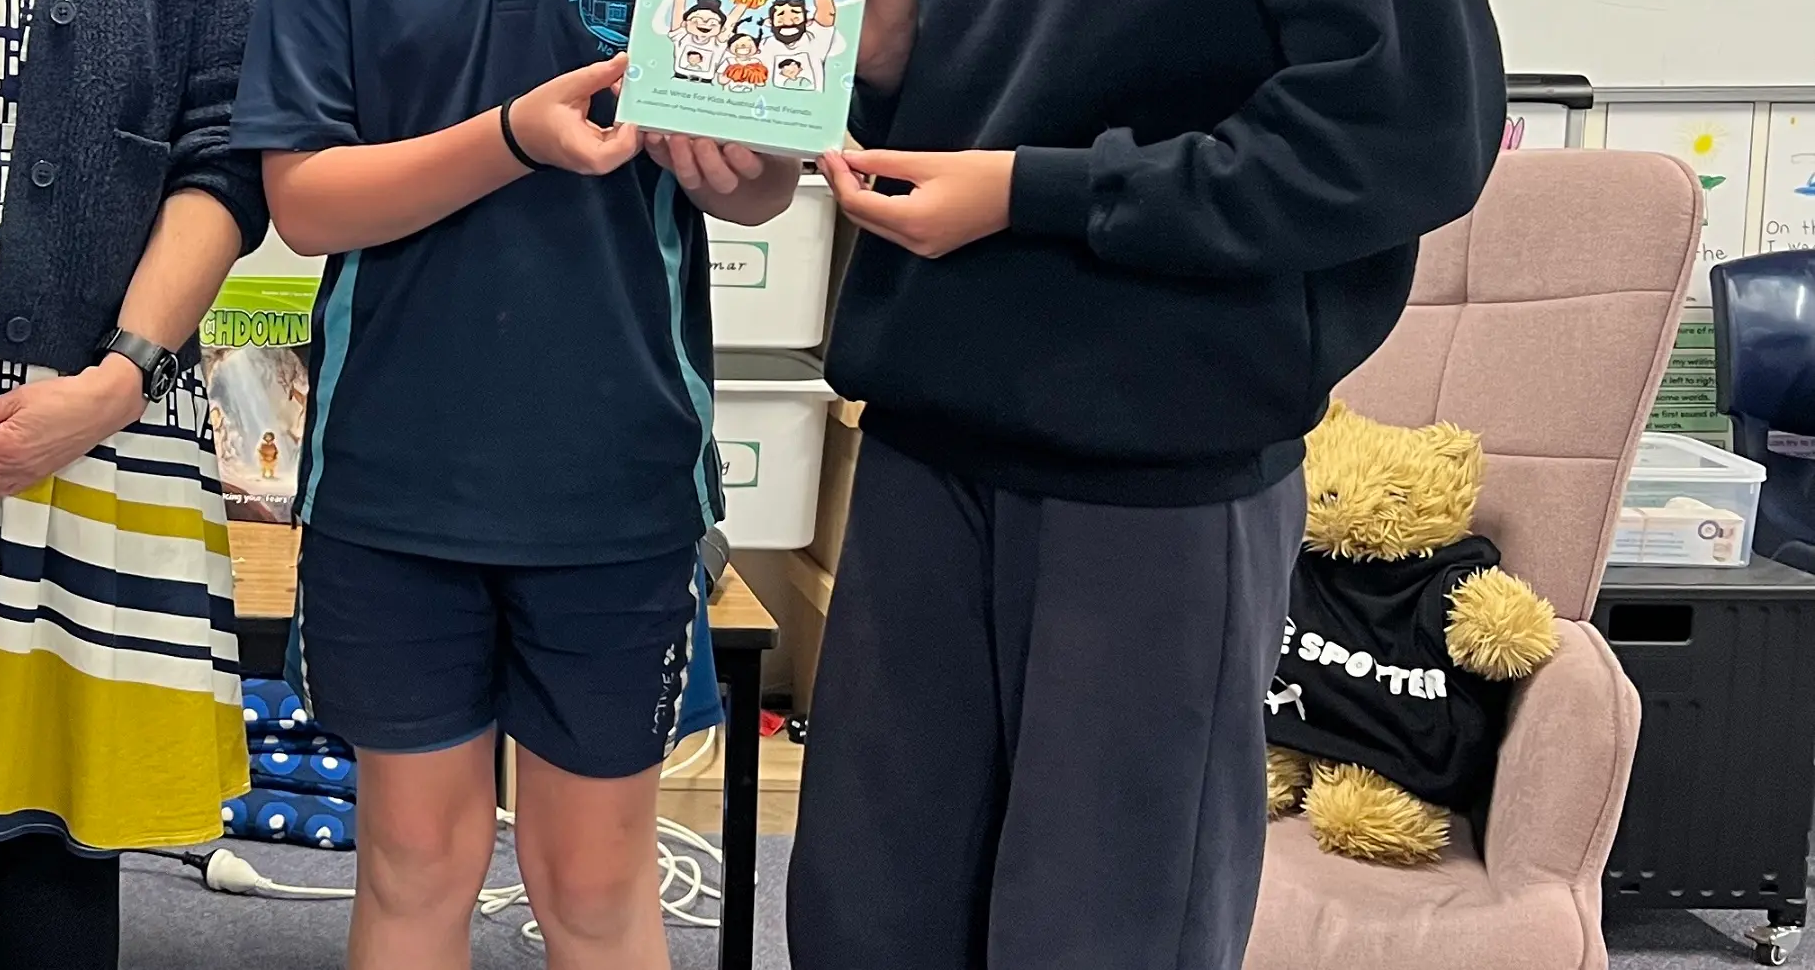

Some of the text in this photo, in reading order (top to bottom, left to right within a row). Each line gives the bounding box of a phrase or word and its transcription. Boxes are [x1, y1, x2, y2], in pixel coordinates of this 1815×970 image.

[1766, 220, 1790, 235] On
[1696, 243, 1727, 261] he
[1298, 632, 1448, 700] SPOTTER
